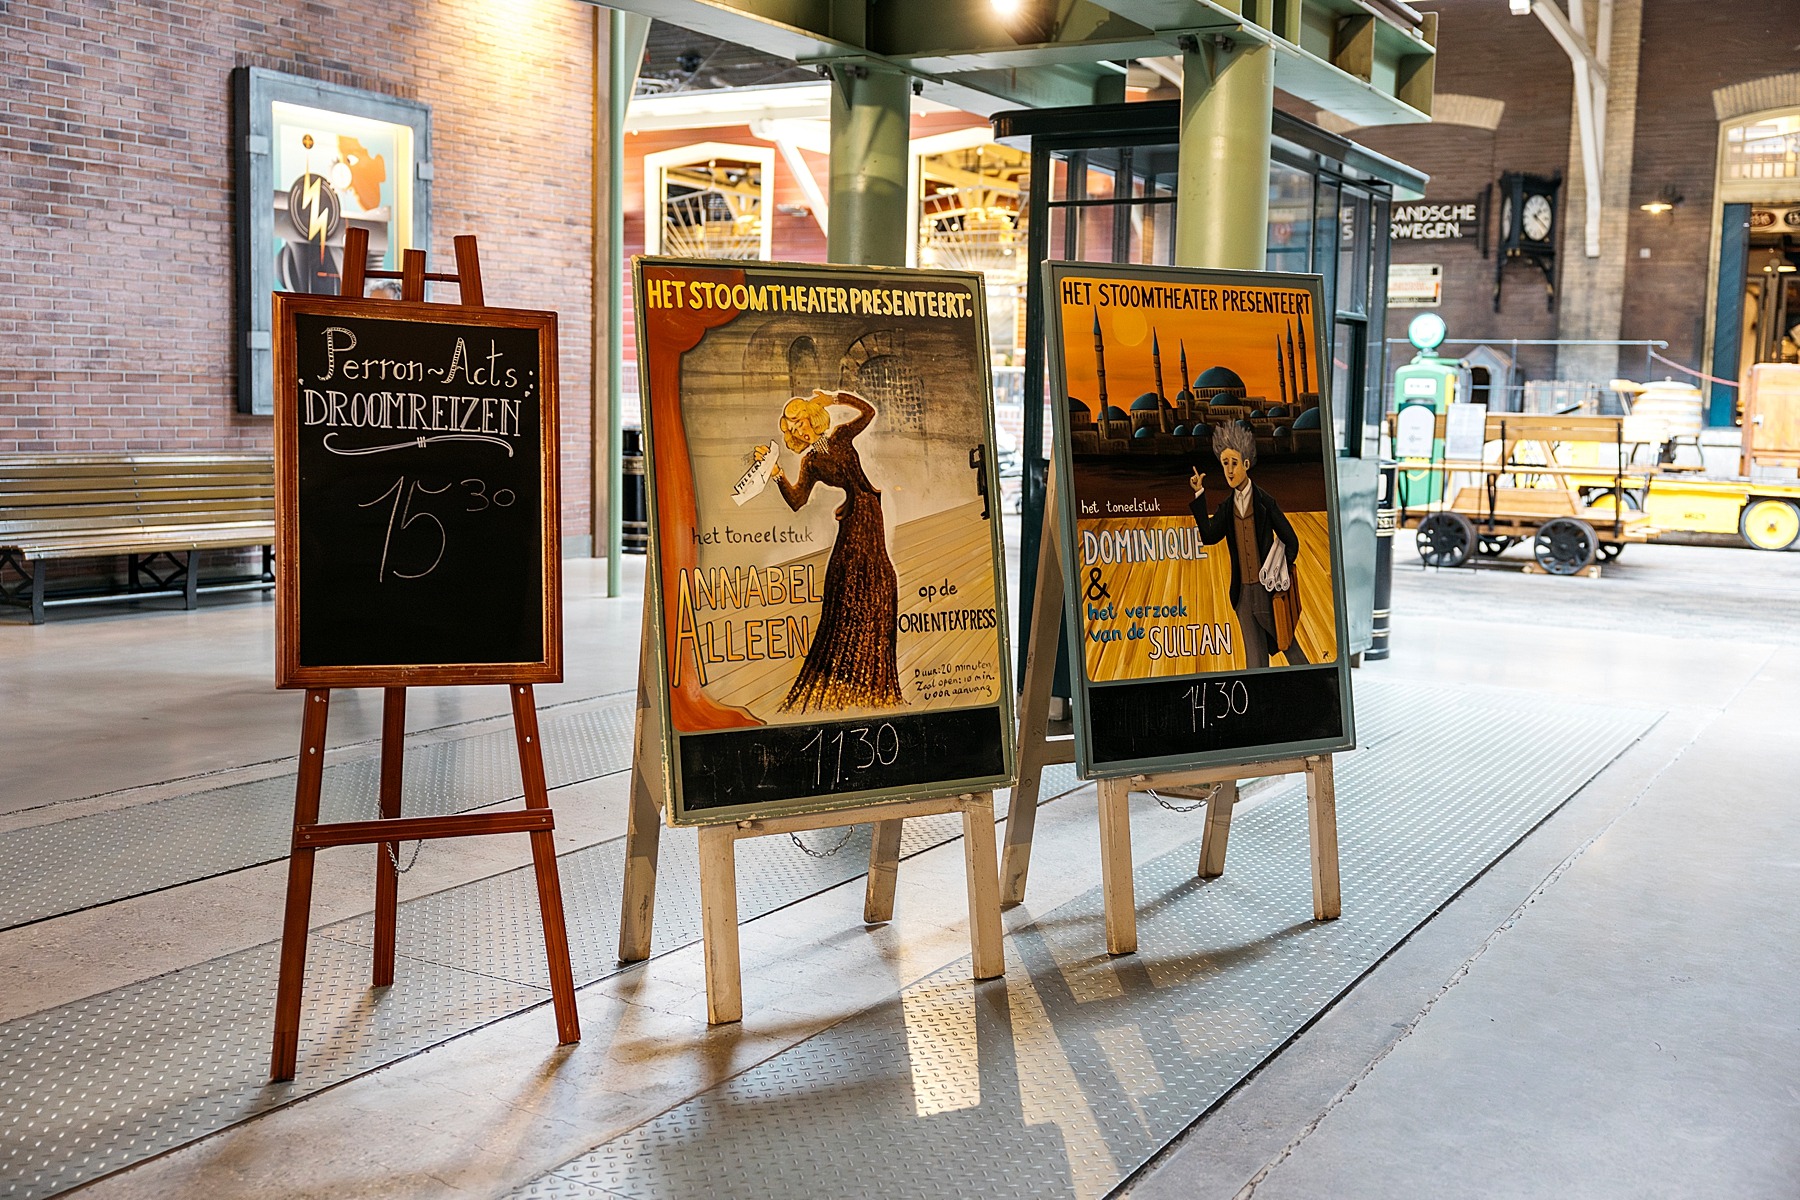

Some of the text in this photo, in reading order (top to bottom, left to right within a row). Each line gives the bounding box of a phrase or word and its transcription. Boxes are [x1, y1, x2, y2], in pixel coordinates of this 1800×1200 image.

[647, 279, 686, 309] HET
[689, 281, 848, 314] STOOMTHEATER
[1062, 281, 1311, 315] HET STOOMTHEATER PRESENTEERT
[1081, 497, 1161, 514] het toneelstuk
[691, 525, 814, 546] het toneelstuk
[1083, 526, 1209, 566] DOMINIQUE
[918, 578, 958, 603] op de
[1087, 567, 1111, 601] &
[672, 564, 824, 650] ANNABEL
[898, 608, 997, 634] ORIENTEXPRESS
[1087, 595, 1188, 621] het verzoek
[1089, 621, 1233, 661] van de SULTAN
[955, 660, 992, 672] minuten
[952, 684, 993, 698] aanvang
[1182, 680, 1249, 733] 14.30
